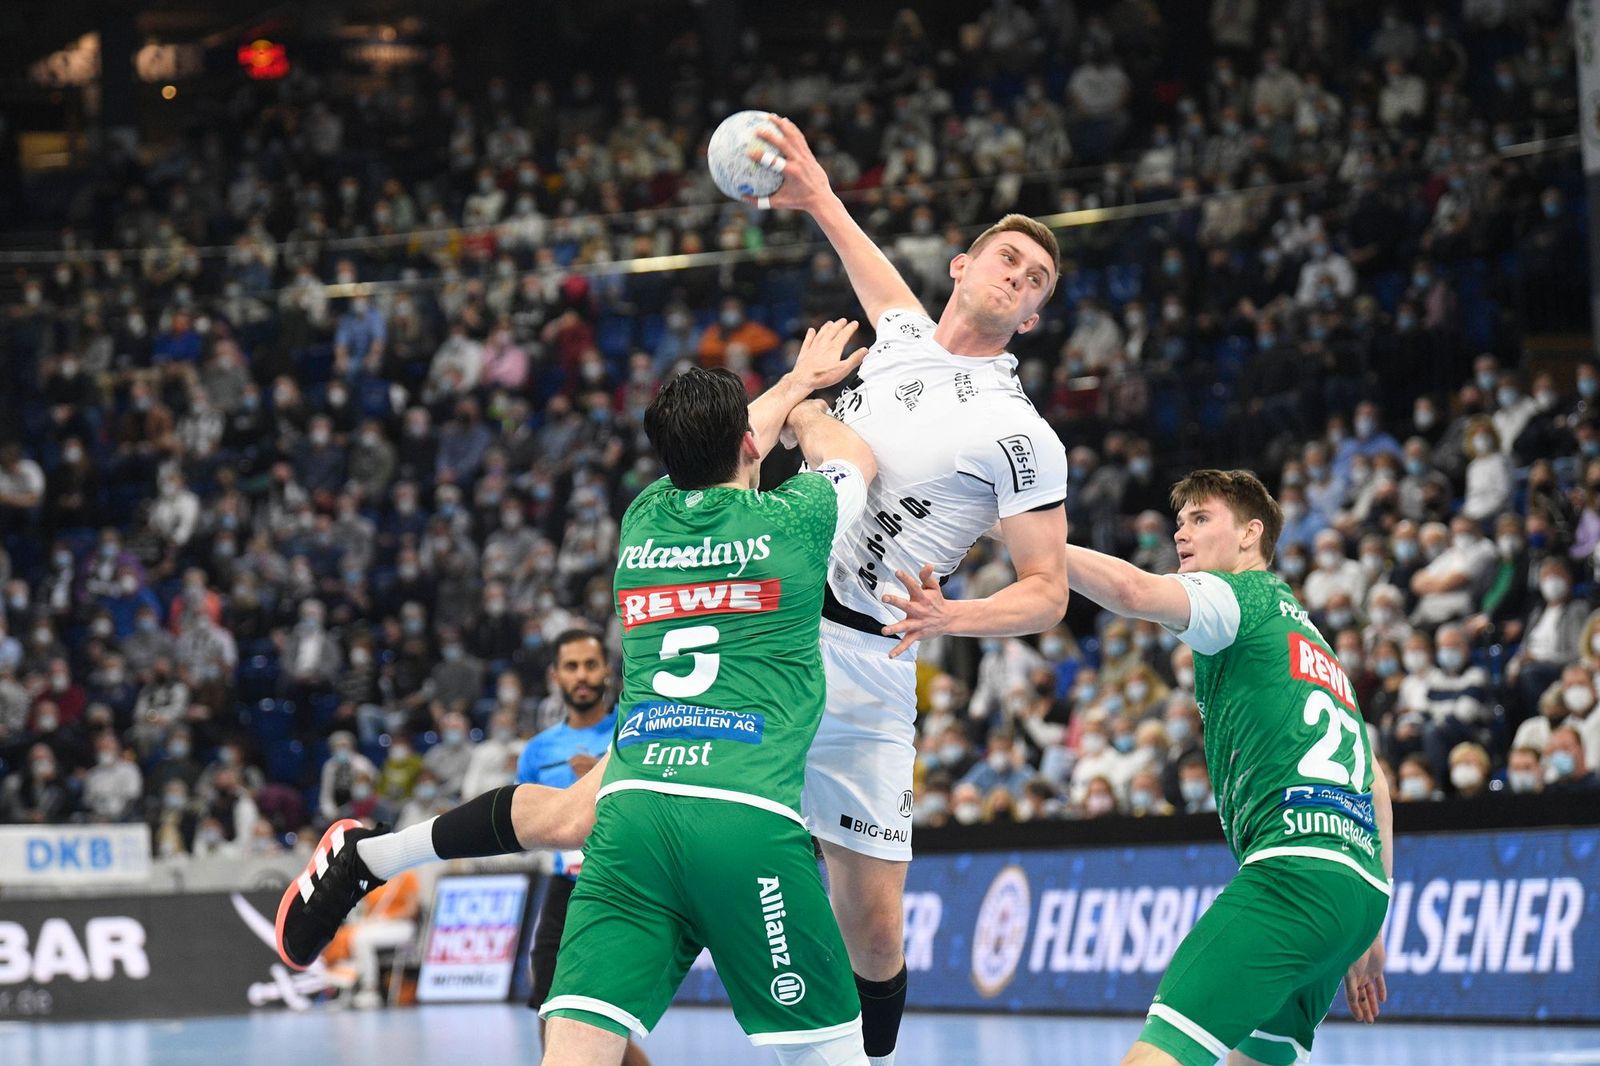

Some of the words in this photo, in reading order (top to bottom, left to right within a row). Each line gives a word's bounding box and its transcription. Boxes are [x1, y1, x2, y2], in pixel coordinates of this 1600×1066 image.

[1008, 439, 1036, 487] reis-fit
[617, 534, 771, 577] relaxdays
[624, 583, 762, 625] REWE
[652, 625, 720, 698] 5
[645, 716, 730, 732] IMMOBILIEN
[1297, 689, 1366, 794] 27
[642, 741, 713, 766] Ernst
[853, 819, 908, 842] BIG-BAU
[26, 836, 114, 873] DKB
[757, 875, 791, 969] Allianz
[1028, 886, 1226, 974] FLENSBU
[1382, 877, 1585, 975] LSENER
